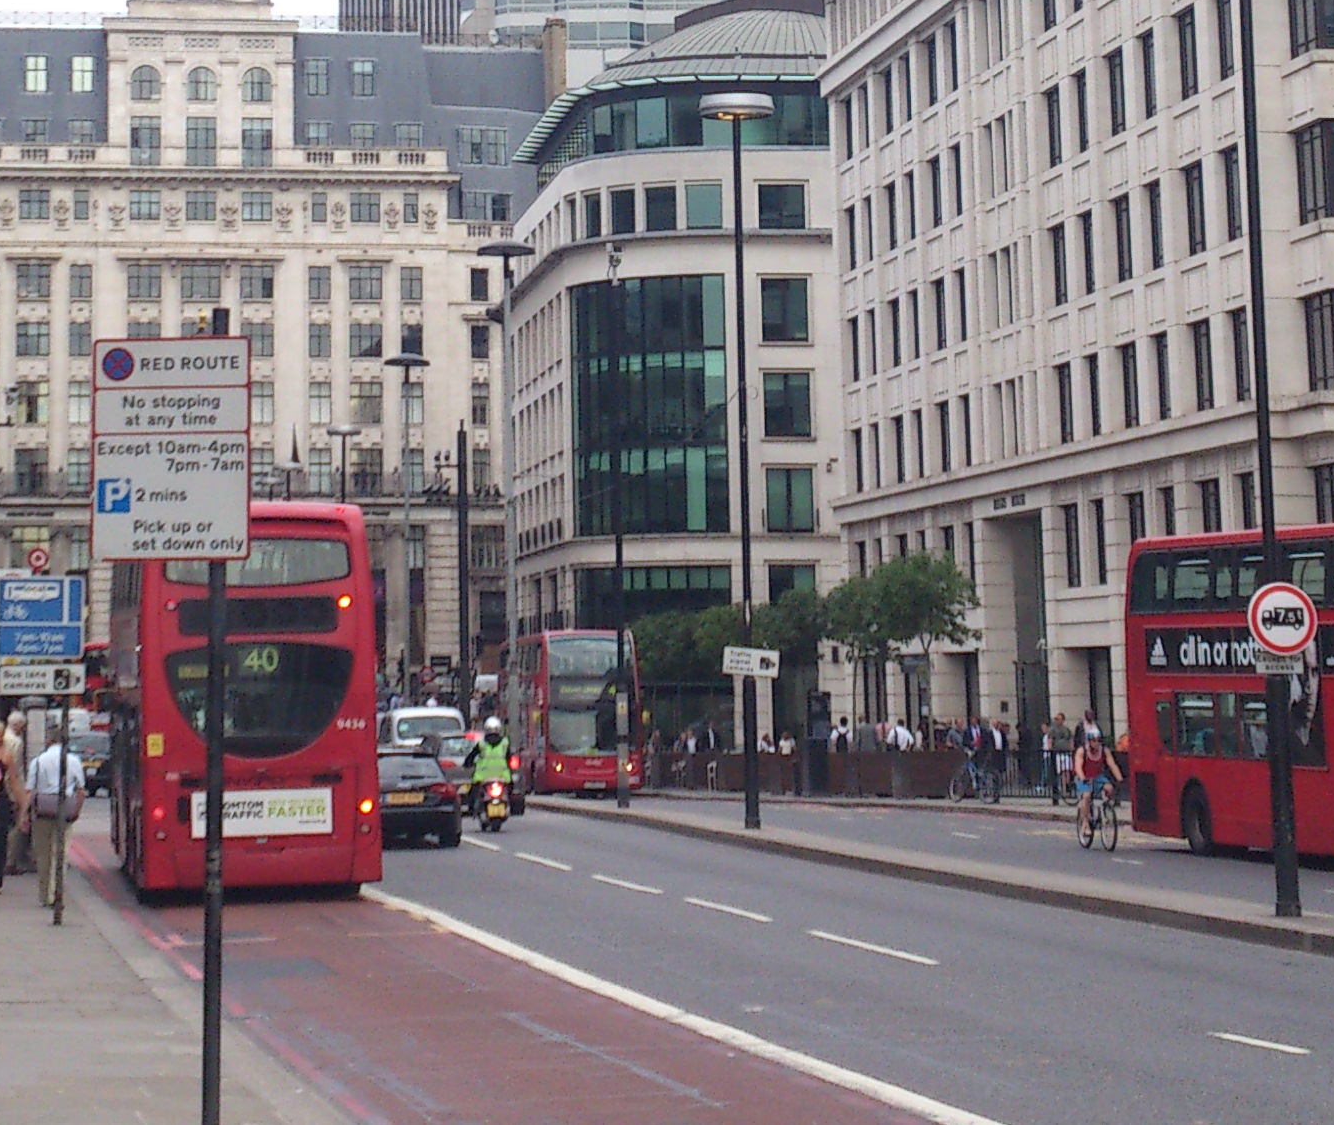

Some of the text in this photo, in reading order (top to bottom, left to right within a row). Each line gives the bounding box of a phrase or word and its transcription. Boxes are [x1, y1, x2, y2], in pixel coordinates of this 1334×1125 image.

[140, 355, 240, 371] RED ROUTE
[122, 394, 221, 410] No stopping
[125, 412, 217, 429] at any time
[97, 440, 245, 457] Except 10am-4pm
[135, 488, 188, 502] 2 mins
[133, 519, 213, 535] Pick up or
[132, 536, 244, 553] set down only
[1197, 635, 1212, 666] in
[1213, 640, 1229, 666] or
[243, 647, 281, 672] 40
[222, 800, 265, 811] OMTOM
[267, 806, 326, 818] FASTER
[222, 810, 265, 820] RAFFIC
